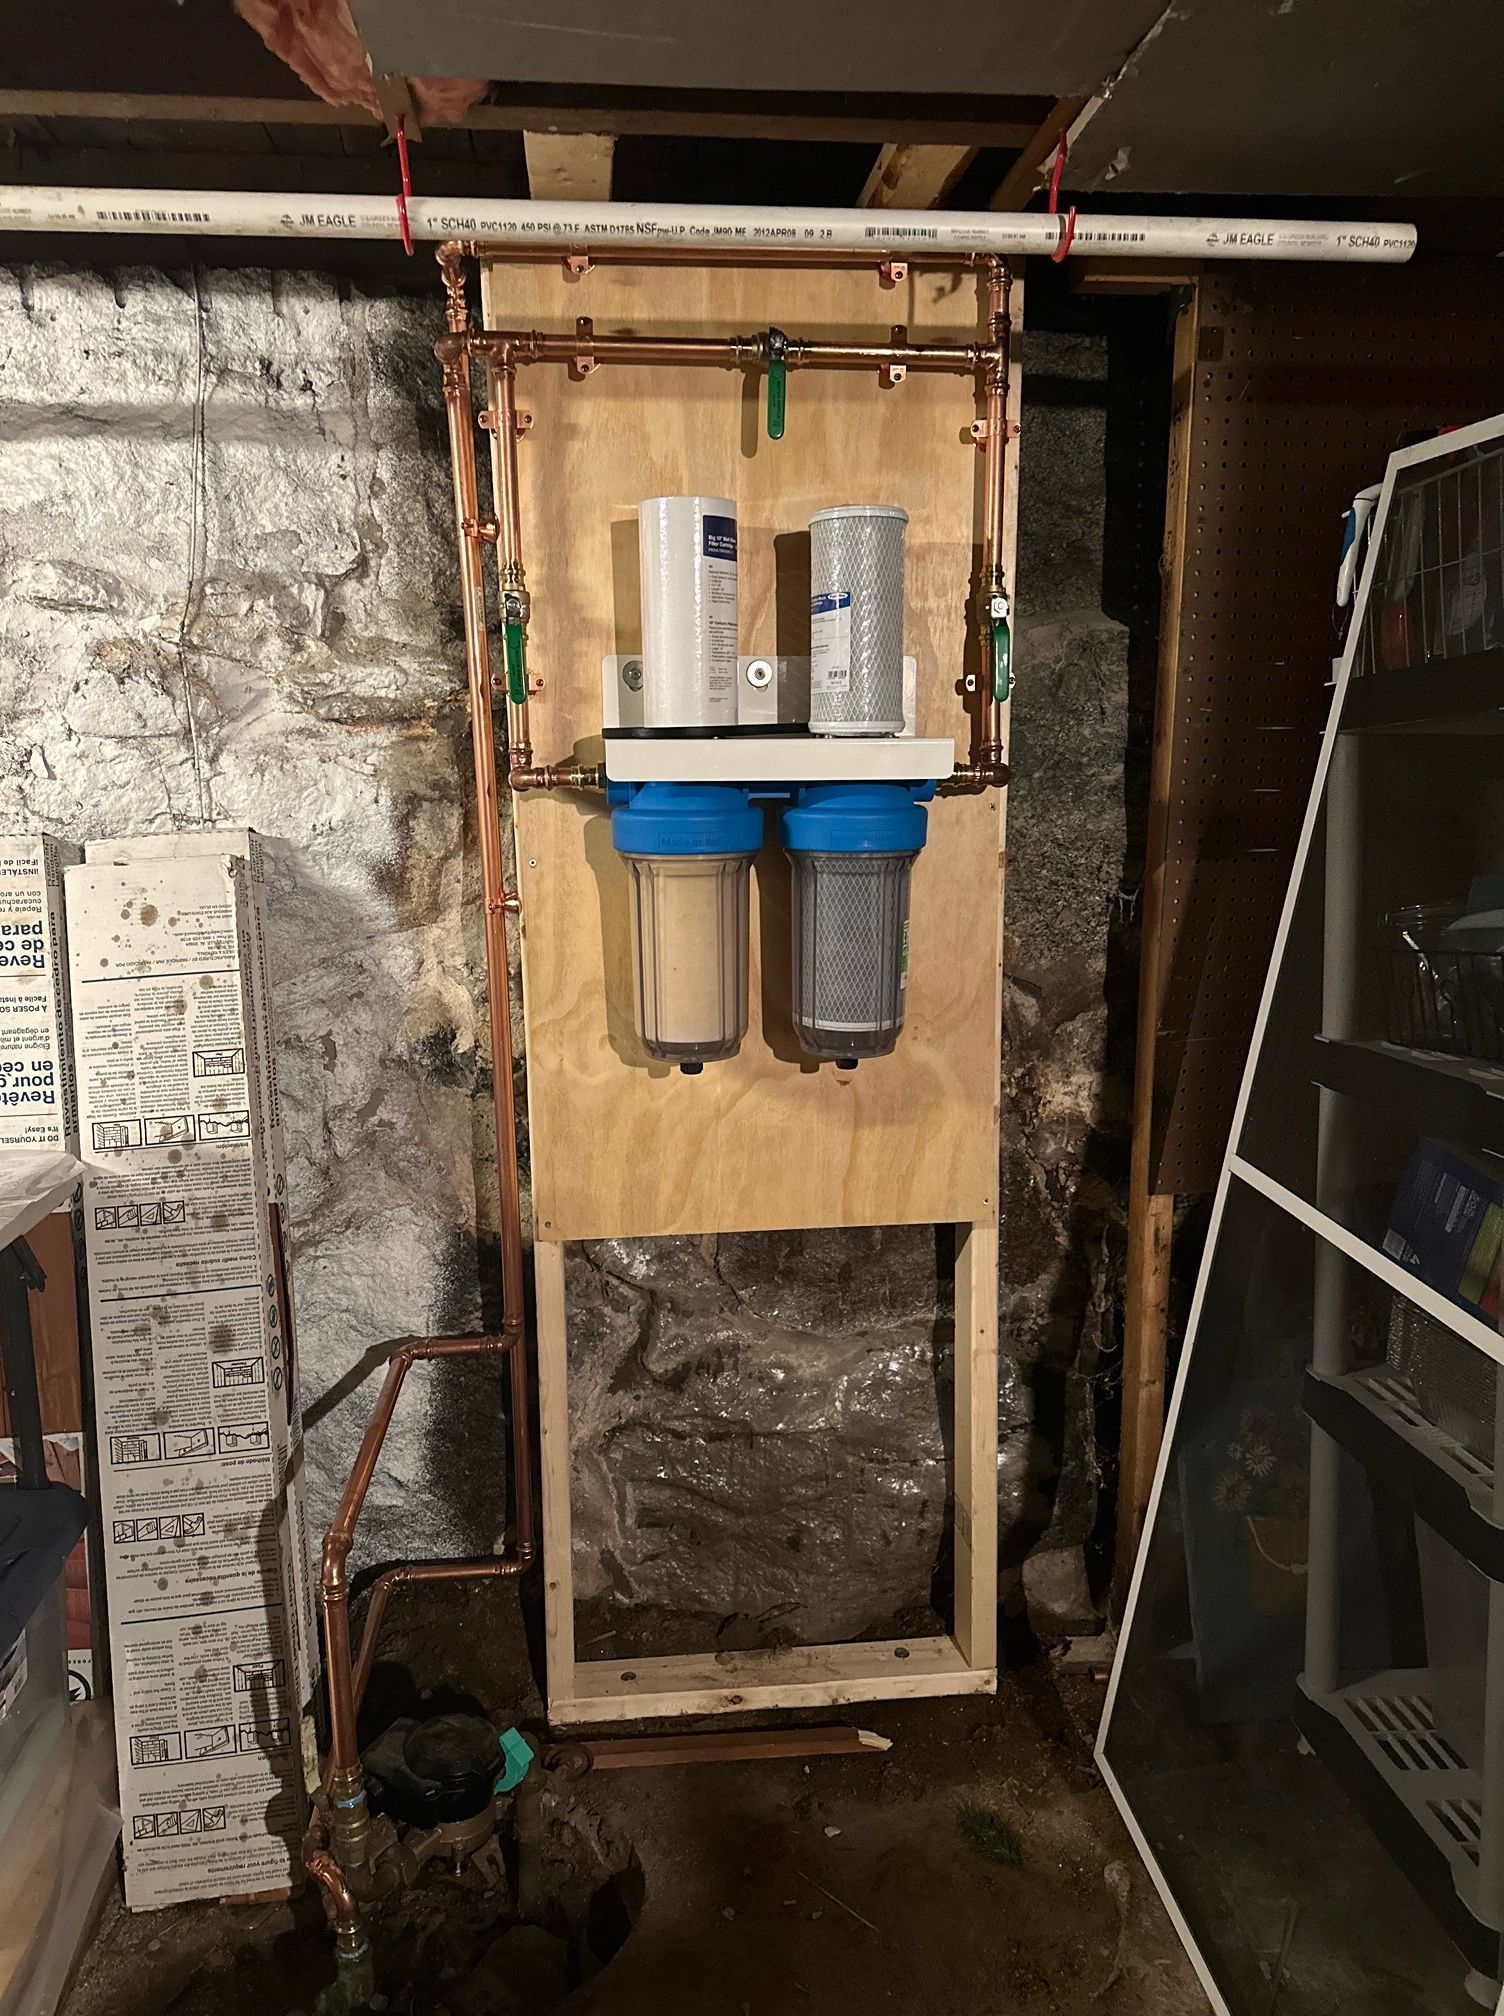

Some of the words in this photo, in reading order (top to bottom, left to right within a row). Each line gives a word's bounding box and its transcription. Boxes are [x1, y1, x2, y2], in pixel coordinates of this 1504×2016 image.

[300, 214, 314, 228] JM
[318, 215, 357, 229] EAGLE
[427, 218, 439, 230] 1"
[441, 218, 477, 231] SCH40
[584, 224, 608, 234] ASTM
[1222, 232, 1238, 246] JM
[1239, 233, 1274, 246] EAGLE
[1336, 235, 1347, 248] 1"
[1348, 236, 1381, 249] SCH40
[1, 921, 43, 936] para
[49, 911, 58, 946] para
[21, 940, 44, 953] de
[55, 998, 62, 1018] de
[32, 1061, 53, 1071] en
[13, 1072, 54, 1087] pour
